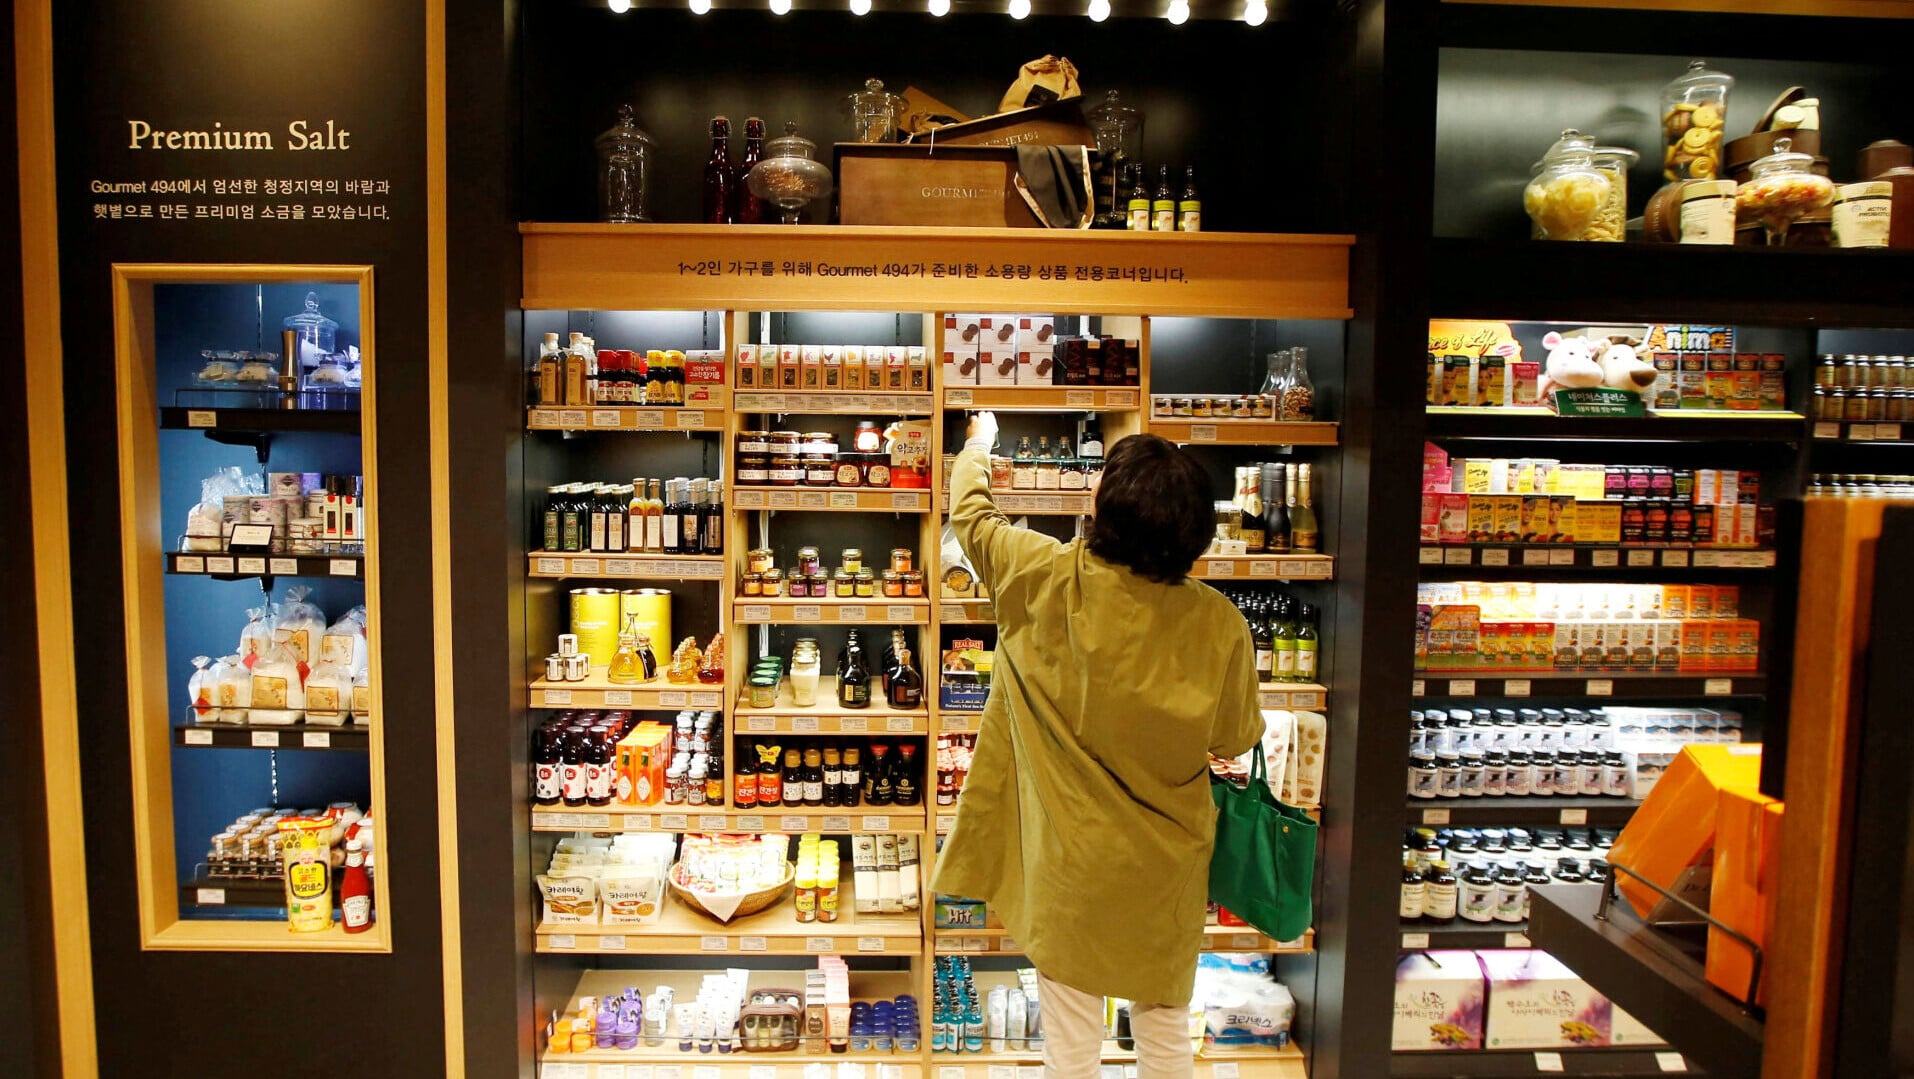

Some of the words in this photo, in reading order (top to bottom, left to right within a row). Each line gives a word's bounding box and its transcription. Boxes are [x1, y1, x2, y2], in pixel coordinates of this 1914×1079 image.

[128, 120, 273, 150] Premium
[288, 120, 350, 150] Salt
[91, 180, 146, 194] Gourmet
[150, 179, 206, 195] 494에서
[213, 179, 258, 195] 엄선한
[263, 179, 339, 195] 청정지역의
[345, 179, 391, 195] 바람과
[94, 204, 154, 219] 햇볕으로
[160, 204, 189, 219] 만든
[195, 205, 255, 220] 프리미엄
[261, 205, 306, 220] 소금을
[312, 205, 390, 221] 모았습니다.
[677, 260, 721, 276] 1~2인
[728, 260, 775, 277] 가구를
[782, 261, 812, 277] 위해
[817, 263, 877, 277] Gourmet
[882, 263, 926, 278] 494가
[932, 263, 979, 278] 준비한
[984, 264, 1032, 279] 소용량
[1038, 265, 1068, 280] 상품
[1074, 265, 1188, 284] 전용코너입니다.
[1225, 1014, 1272, 1028] 크리넥스
